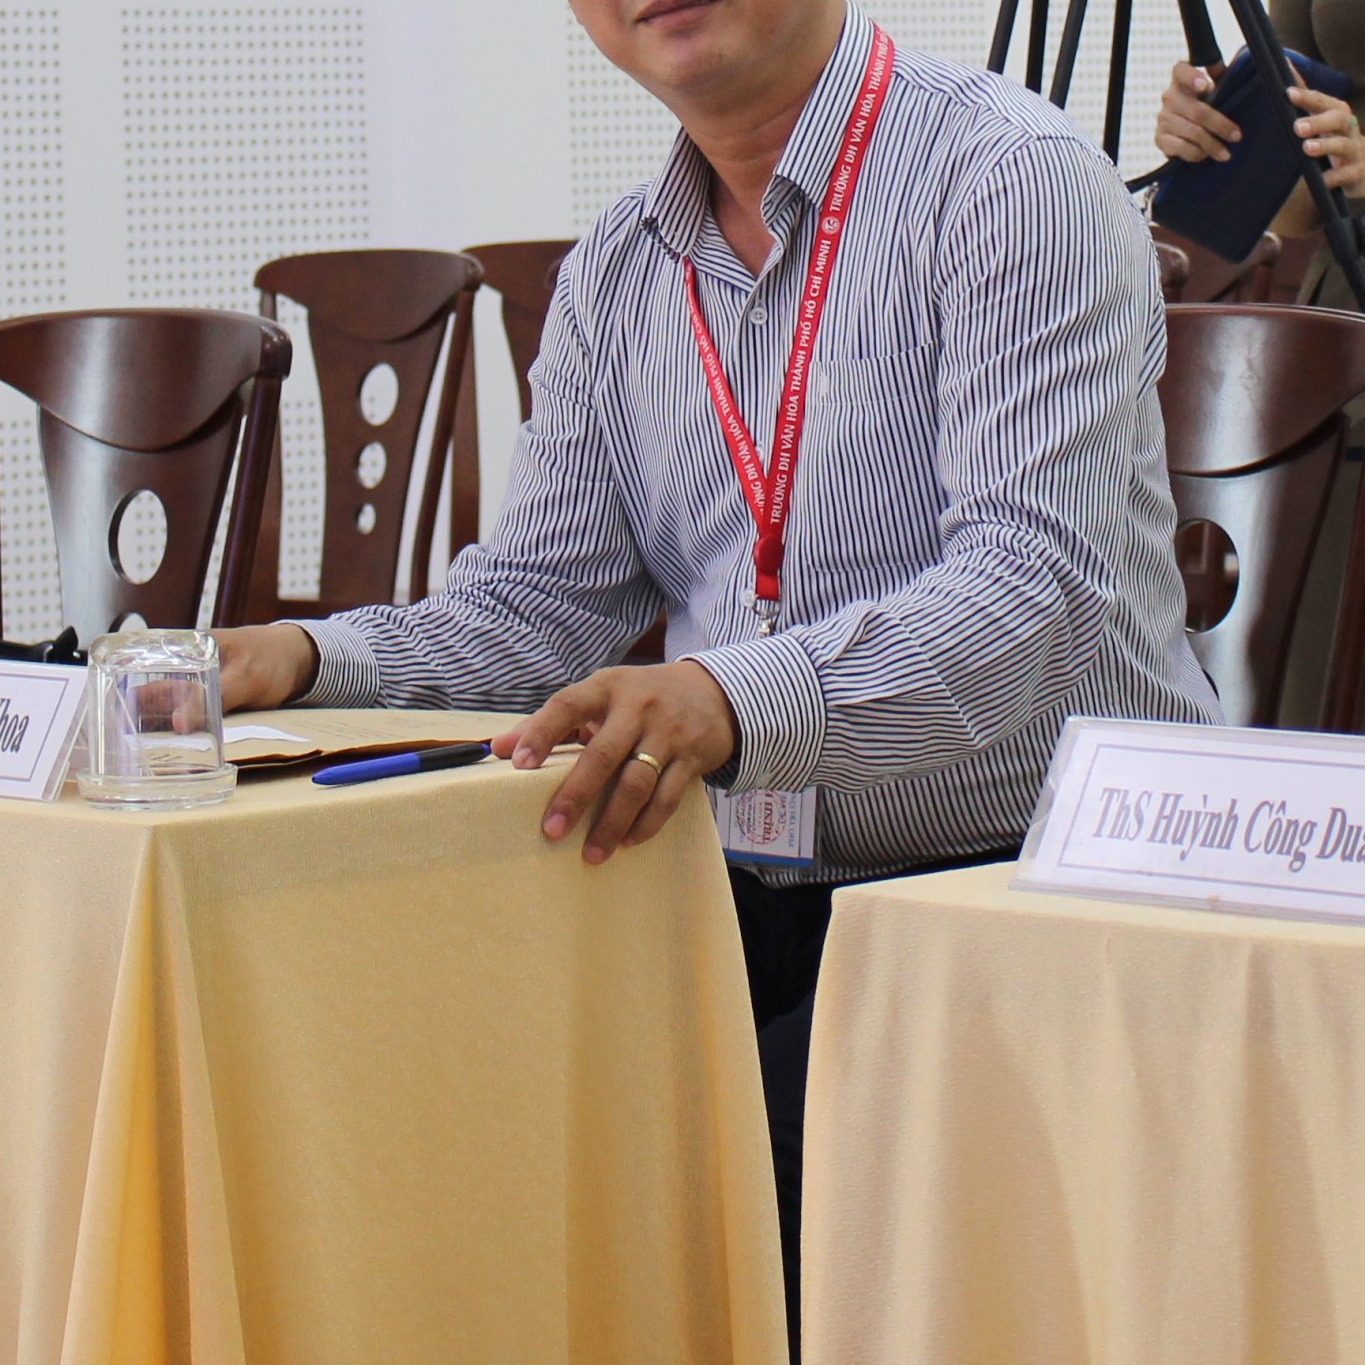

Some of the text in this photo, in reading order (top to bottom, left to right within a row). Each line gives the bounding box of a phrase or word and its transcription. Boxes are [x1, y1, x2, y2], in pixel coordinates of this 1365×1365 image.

[868, 59, 885, 93] THÀNH
[860, 93, 877, 118] HÓA
[850, 118, 868, 143] VĂN
[829, 164, 852, 212] TRƯỜNG
[815, 239, 832, 274] MINH
[809, 275, 823, 298] CHÍ
[804, 300, 817, 319] HỒ
[799, 321, 812, 347] PHỐ
[790, 350, 807, 392] THÀNH
[712, 377, 731, 416] THÀNH
[786, 395, 800, 422] HÓA
[727, 415, 744, 441] HÓA
[781, 424, 796, 450] VĂN
[737, 440, 753, 464] VĂN
[770, 473, 788, 524] TRƯỜNG
[1092, 787, 1151, 841] ThS
[1147, 792, 1239, 861] Huỳnh
[1243, 799, 1319, 873] Công
